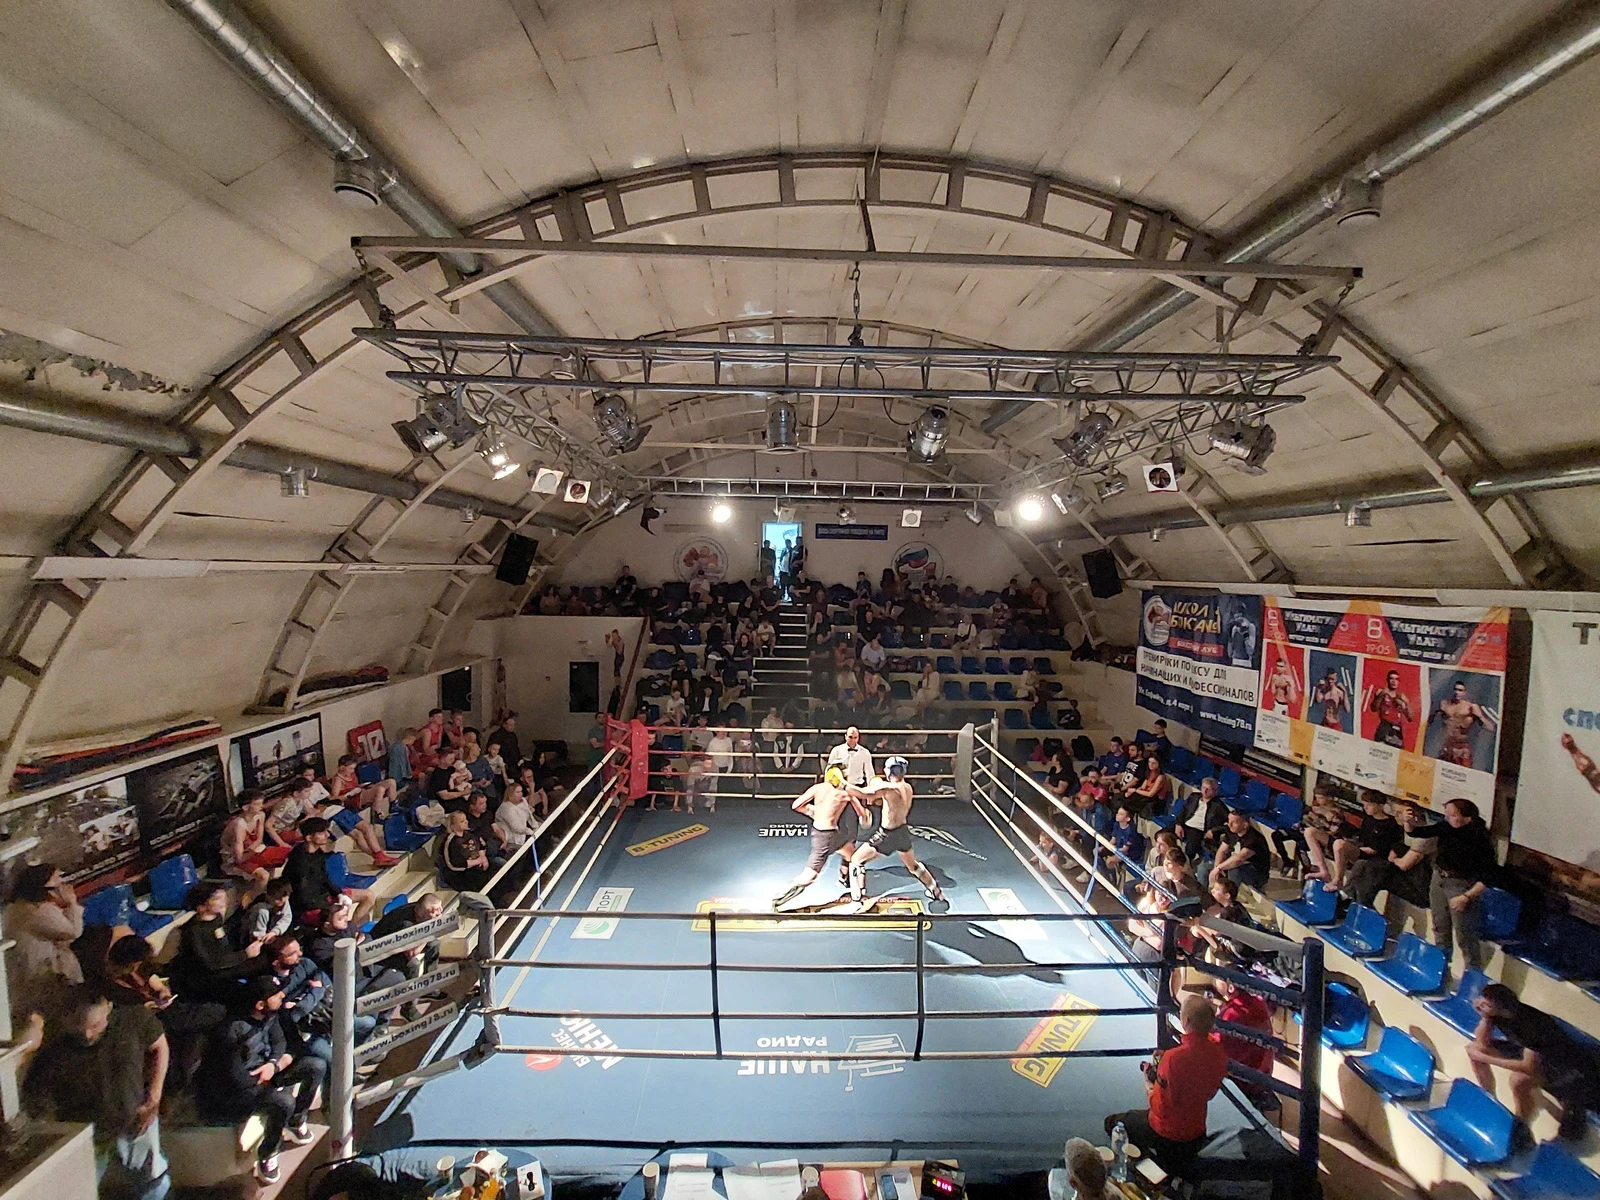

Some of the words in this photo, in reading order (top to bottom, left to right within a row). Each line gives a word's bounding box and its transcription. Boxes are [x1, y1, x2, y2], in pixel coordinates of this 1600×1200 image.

[1367, 618, 1382, 639] 8
[1181, 660, 1191, 671] ПО
[758, 827, 809, 838] НАШЕ
[364, 913, 457, 953] www.boxing78.ru
[362, 968, 456, 1008] www.boxing78.ru
[550, 1027, 591, 1068] БИНЕС
[756, 1035, 828, 1048] РАДИО
[736, 1051, 830, 1075] НАШЕ
